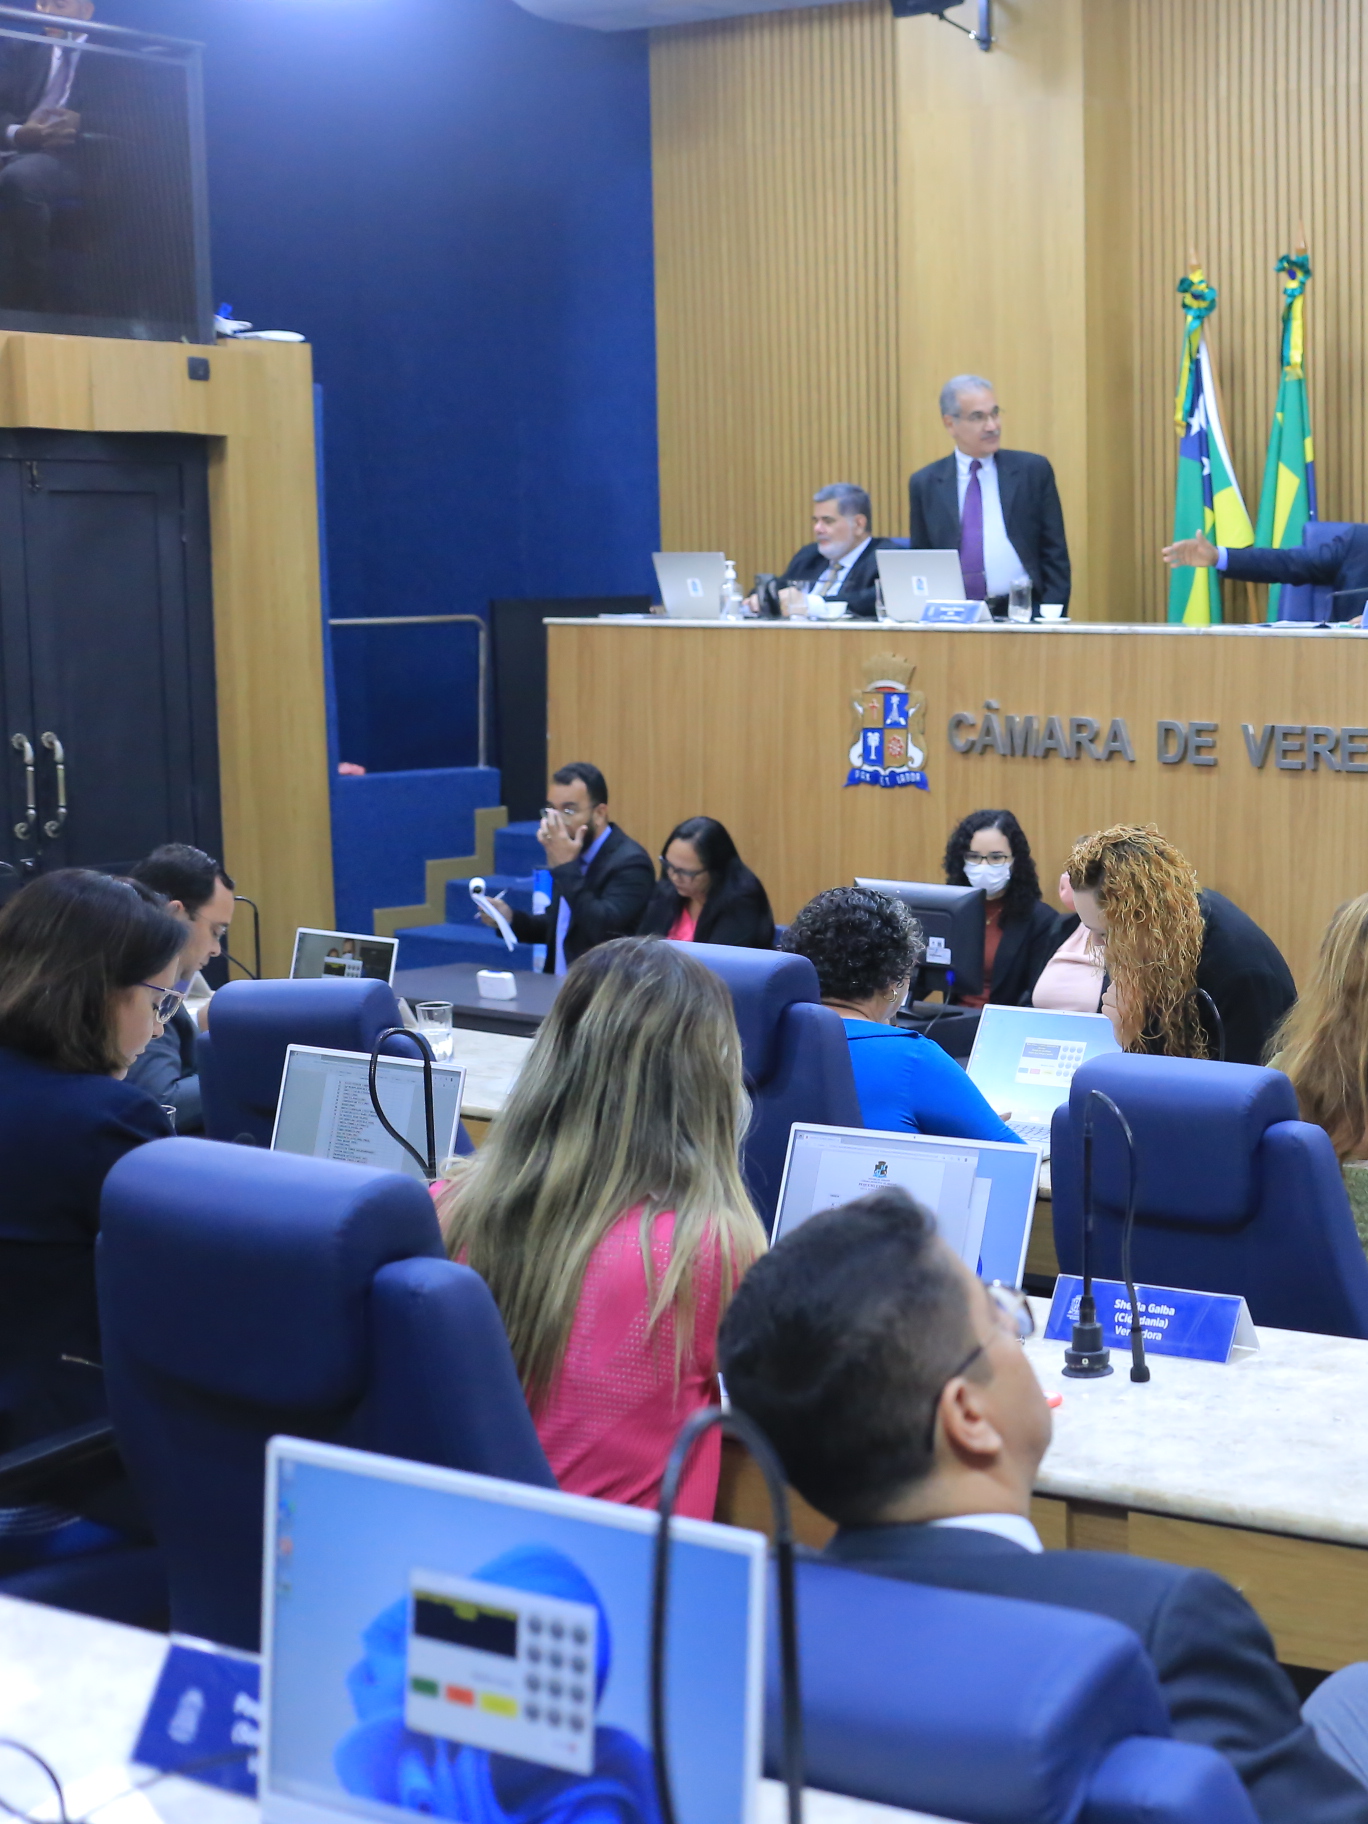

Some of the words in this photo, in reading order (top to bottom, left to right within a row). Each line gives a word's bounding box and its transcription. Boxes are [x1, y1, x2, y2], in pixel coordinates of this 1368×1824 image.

[948, 699, 1135, 763] CÂMARA
[1157, 720, 1218, 766] DE
[1113, 1298, 1146, 1313] Shela
[1148, 1303, 1176, 1316] Galba
[1114, 1312, 1169, 1330] (Ciddania)
[1115, 1325, 1163, 1341] Verdora
